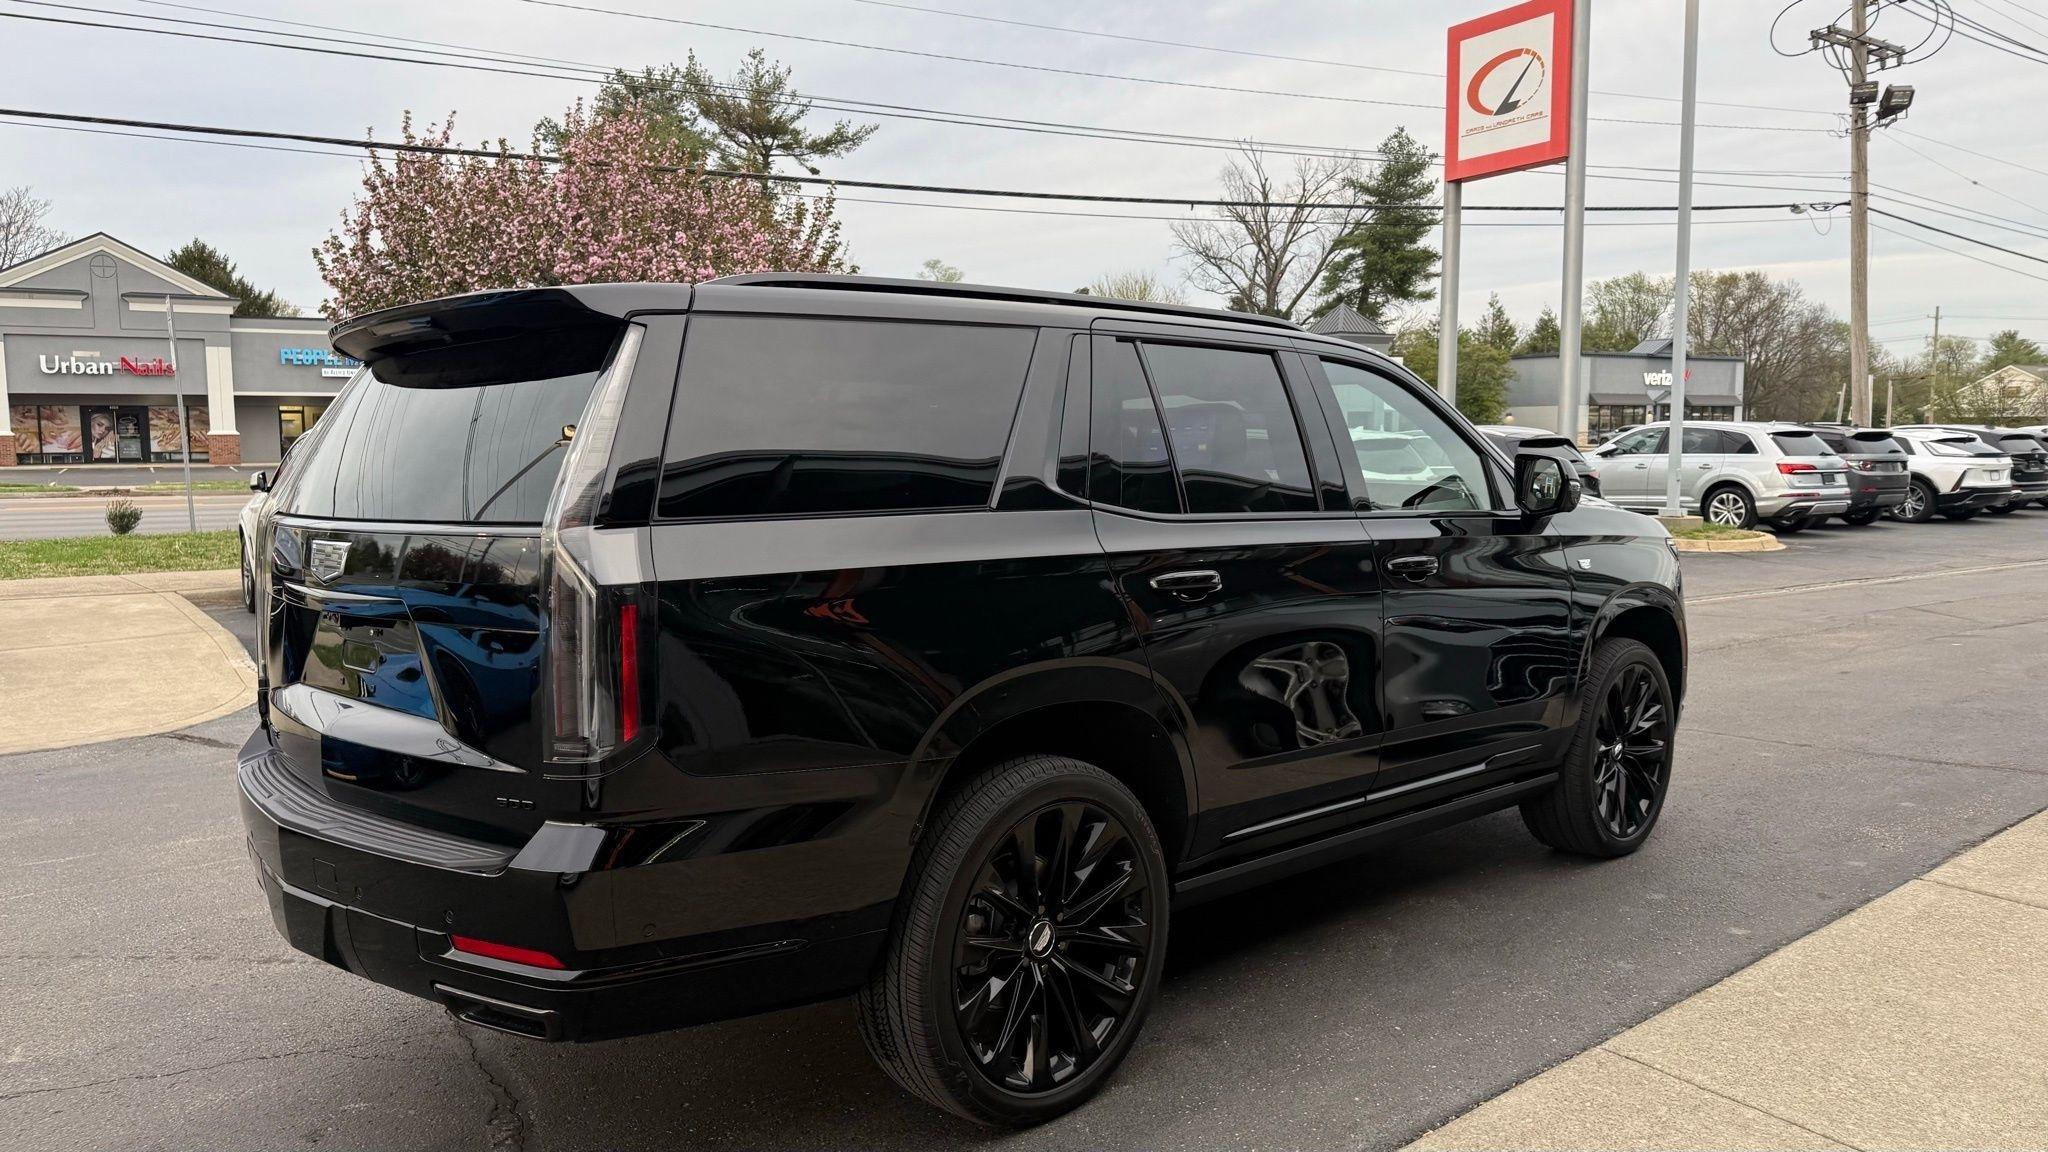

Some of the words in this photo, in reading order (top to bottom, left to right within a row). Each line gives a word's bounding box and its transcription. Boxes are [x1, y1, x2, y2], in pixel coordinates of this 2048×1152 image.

[39, 354, 113, 375] Urban
[120, 356, 175, 376] Nails
[1643, 369, 1673, 386] veriz
